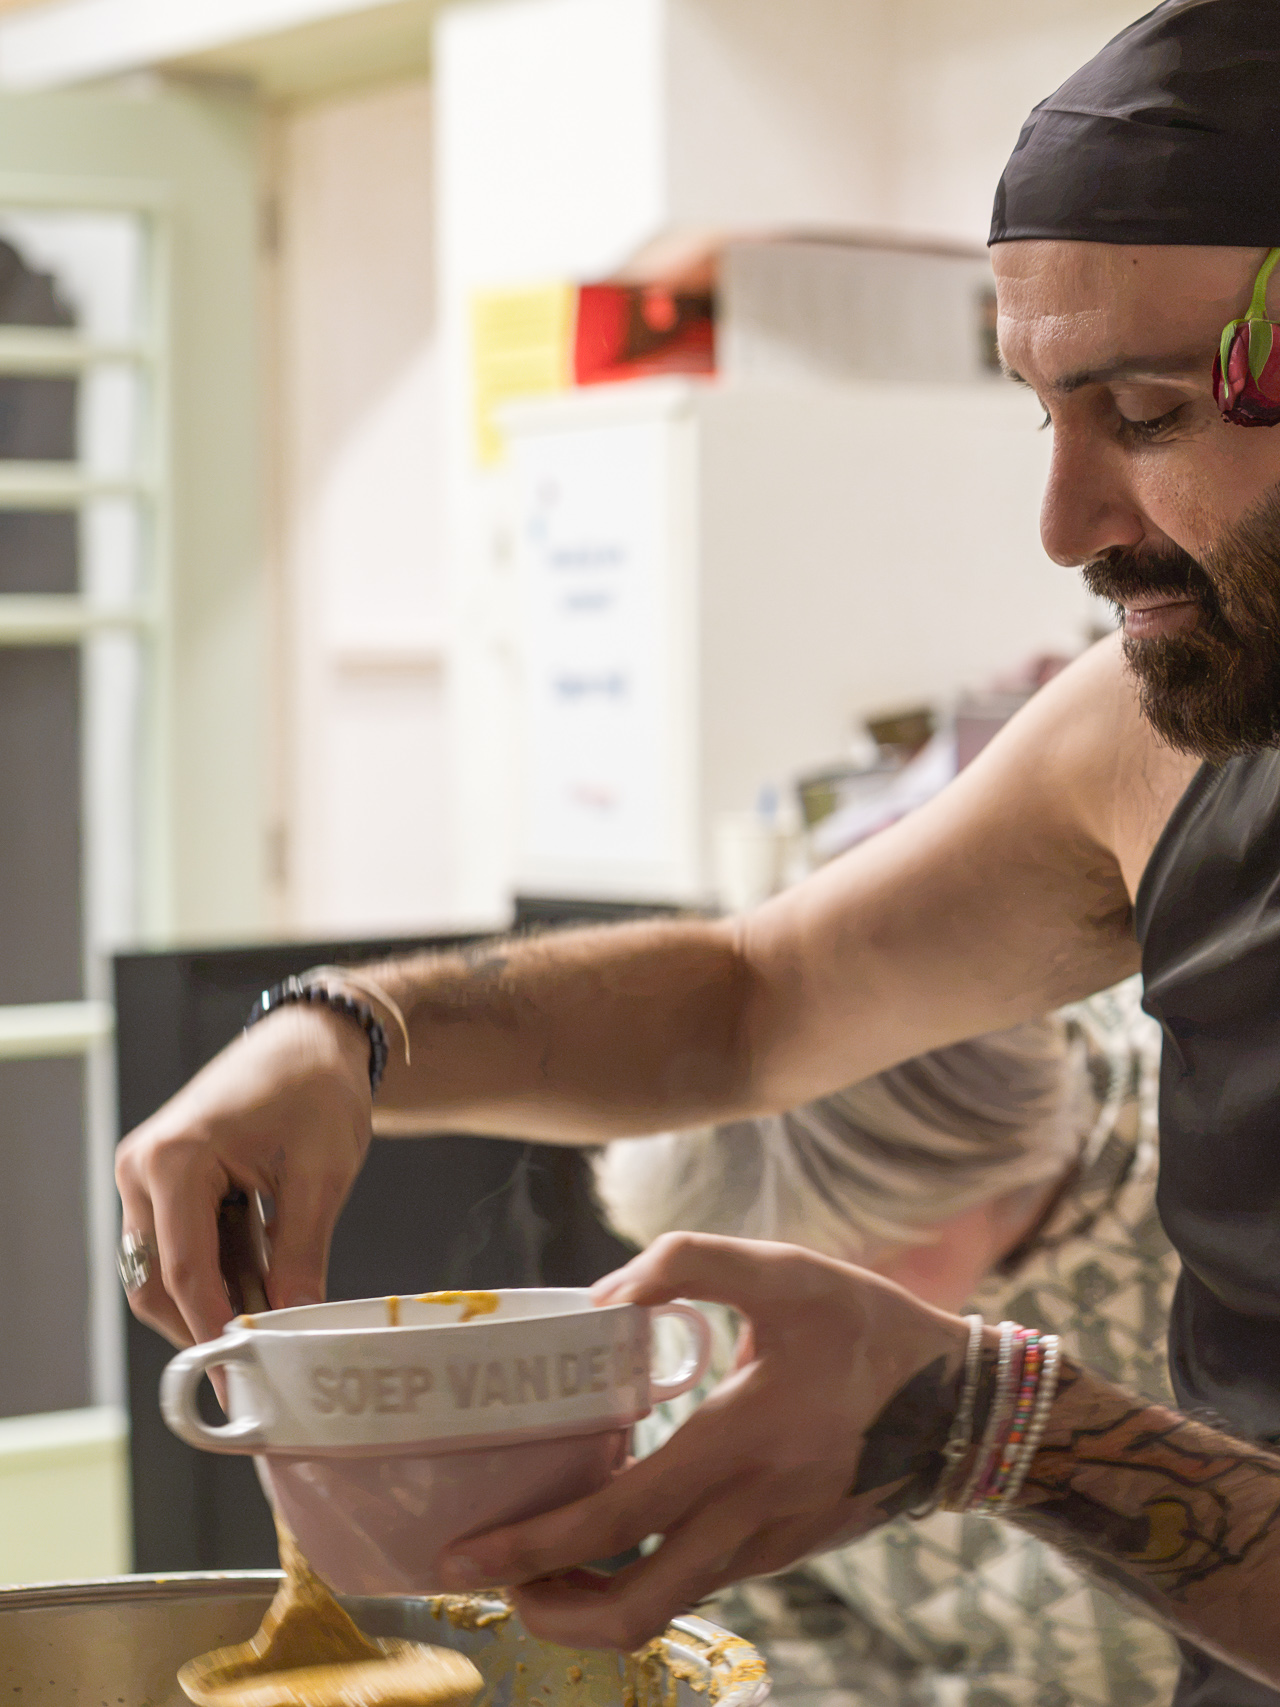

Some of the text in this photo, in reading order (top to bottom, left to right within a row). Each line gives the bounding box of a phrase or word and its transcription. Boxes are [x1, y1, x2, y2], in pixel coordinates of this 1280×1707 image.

[311, 1365, 434, 1416] SOEP
[446, 1355, 550, 1410] VAN
[558, 1346, 611, 1398] DE
